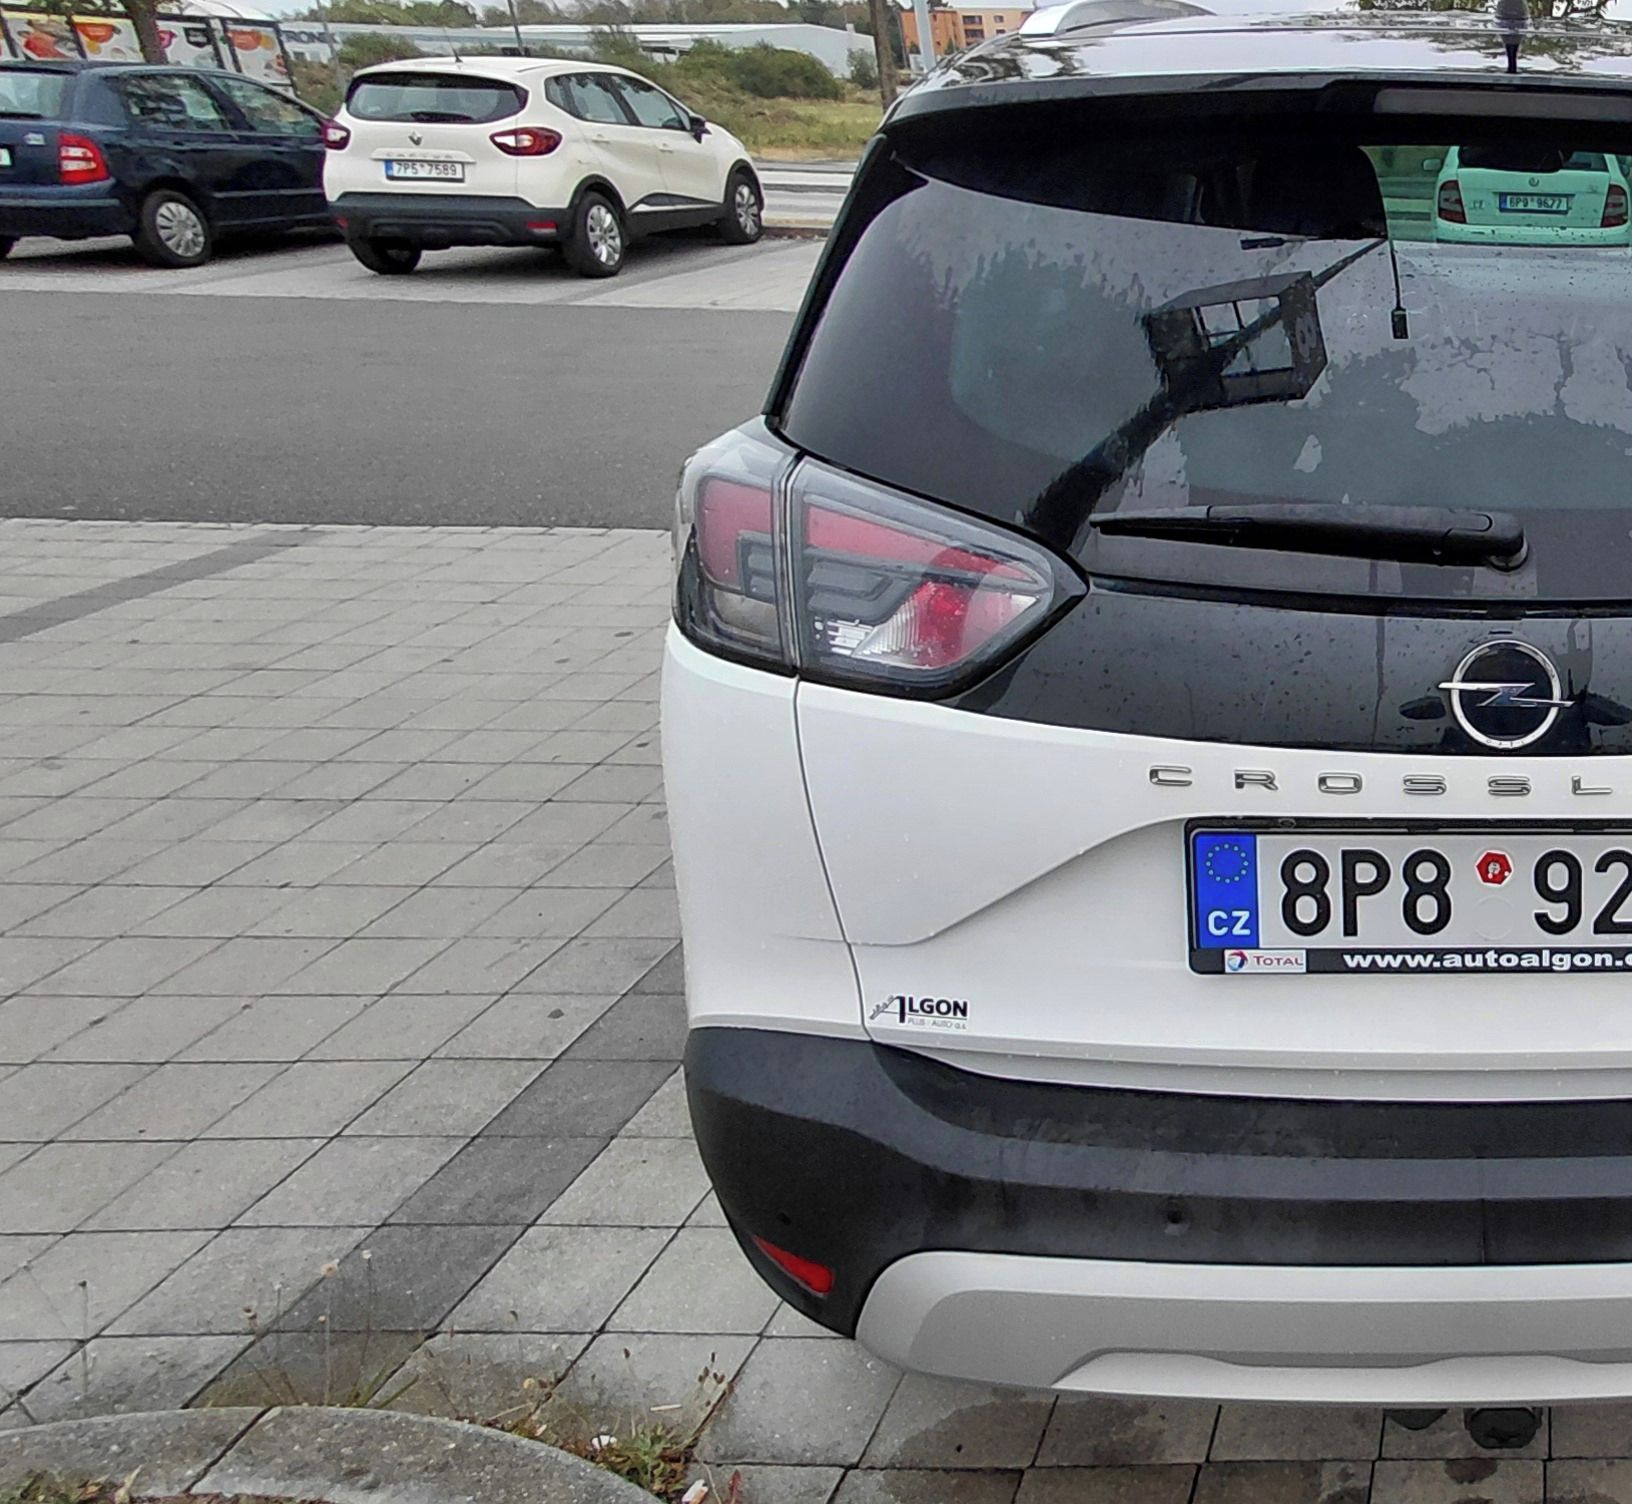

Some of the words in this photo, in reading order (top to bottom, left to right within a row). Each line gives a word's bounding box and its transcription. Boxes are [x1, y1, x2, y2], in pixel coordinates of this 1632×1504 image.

[1280, 848, 1452, 937] 8P8
[1207, 910, 1251, 936] CZ
[1252, 955, 1304, 967] TOTAL
